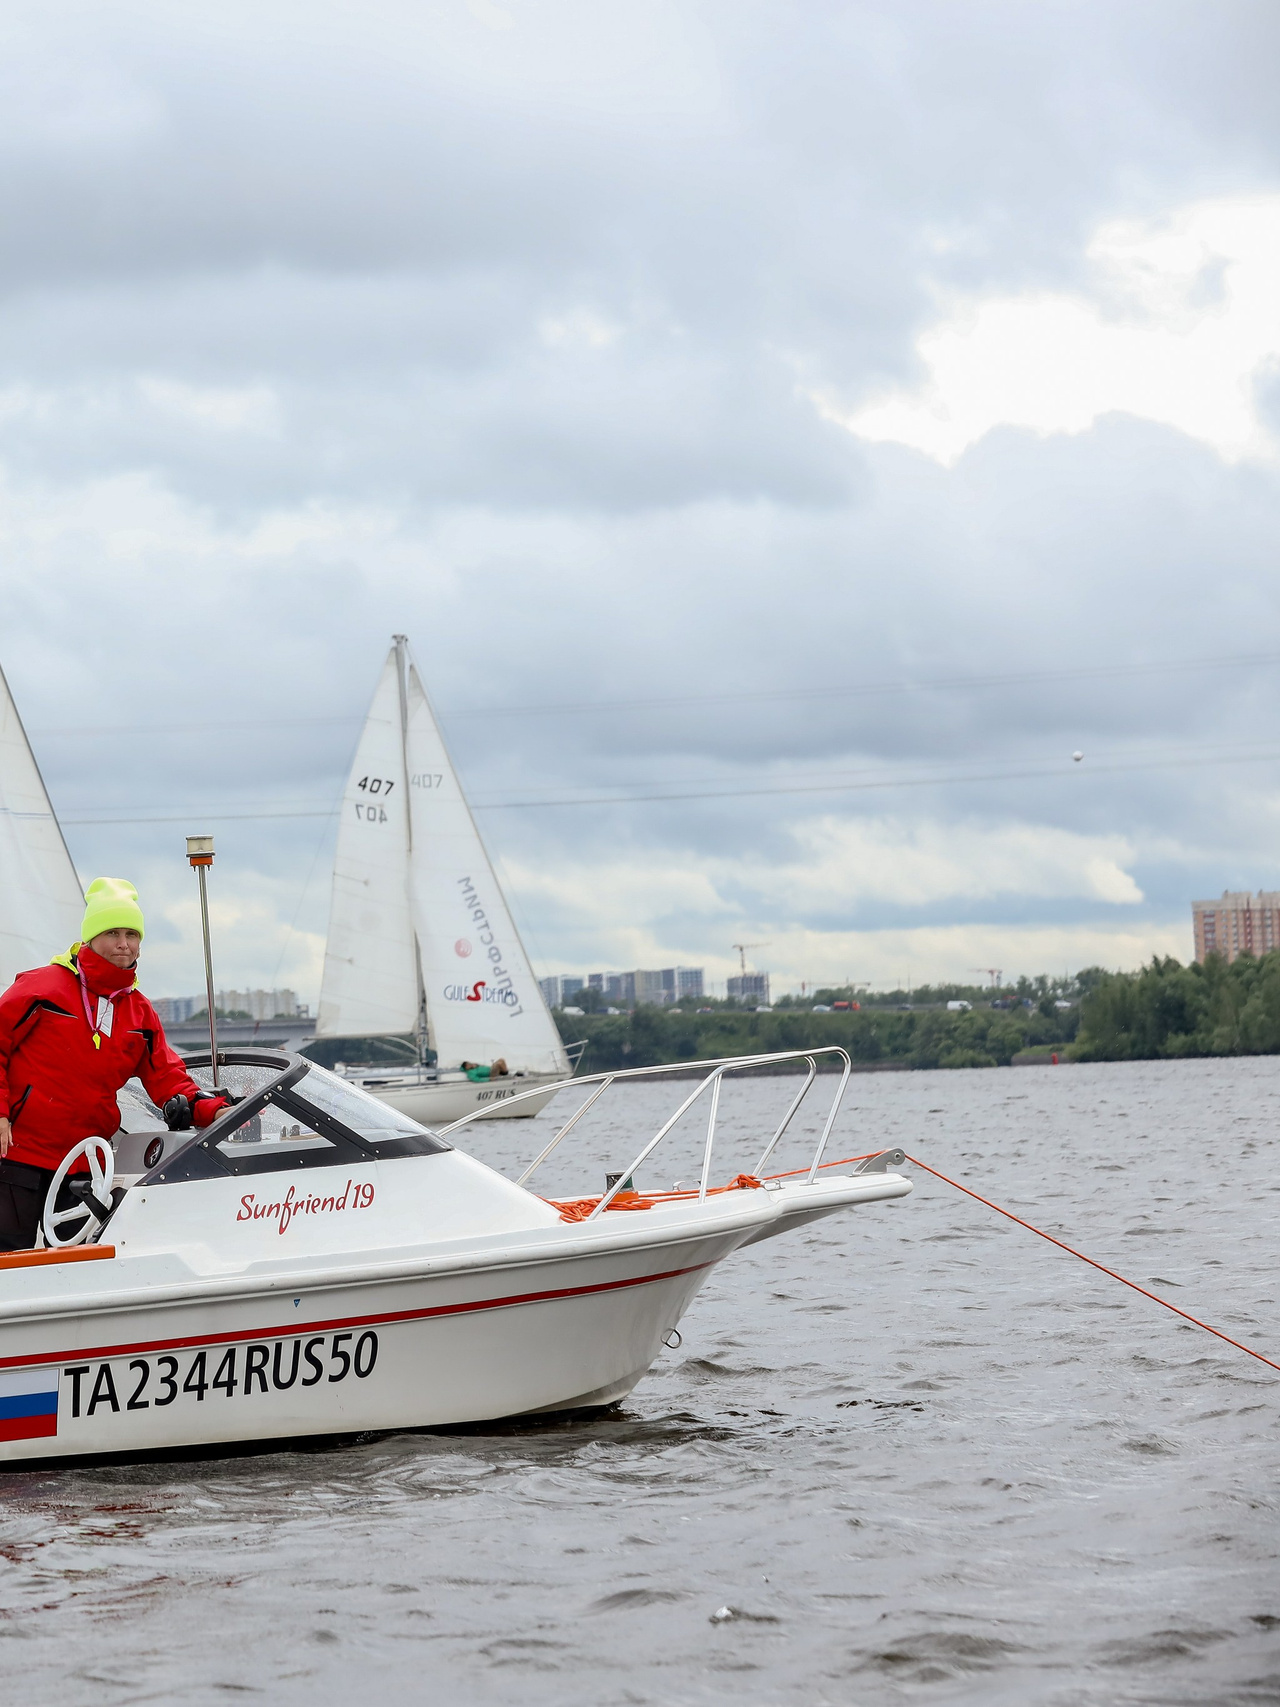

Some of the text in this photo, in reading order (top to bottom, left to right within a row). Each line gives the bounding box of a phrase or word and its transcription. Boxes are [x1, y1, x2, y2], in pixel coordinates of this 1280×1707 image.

[358, 776, 395, 796] 407
[411, 773, 443, 789] 407
[476, 1090, 494, 1101] 407
[236, 1179, 353, 1235] Sunfriend
[64, 1330, 379, 1418] TA2344RUS50
